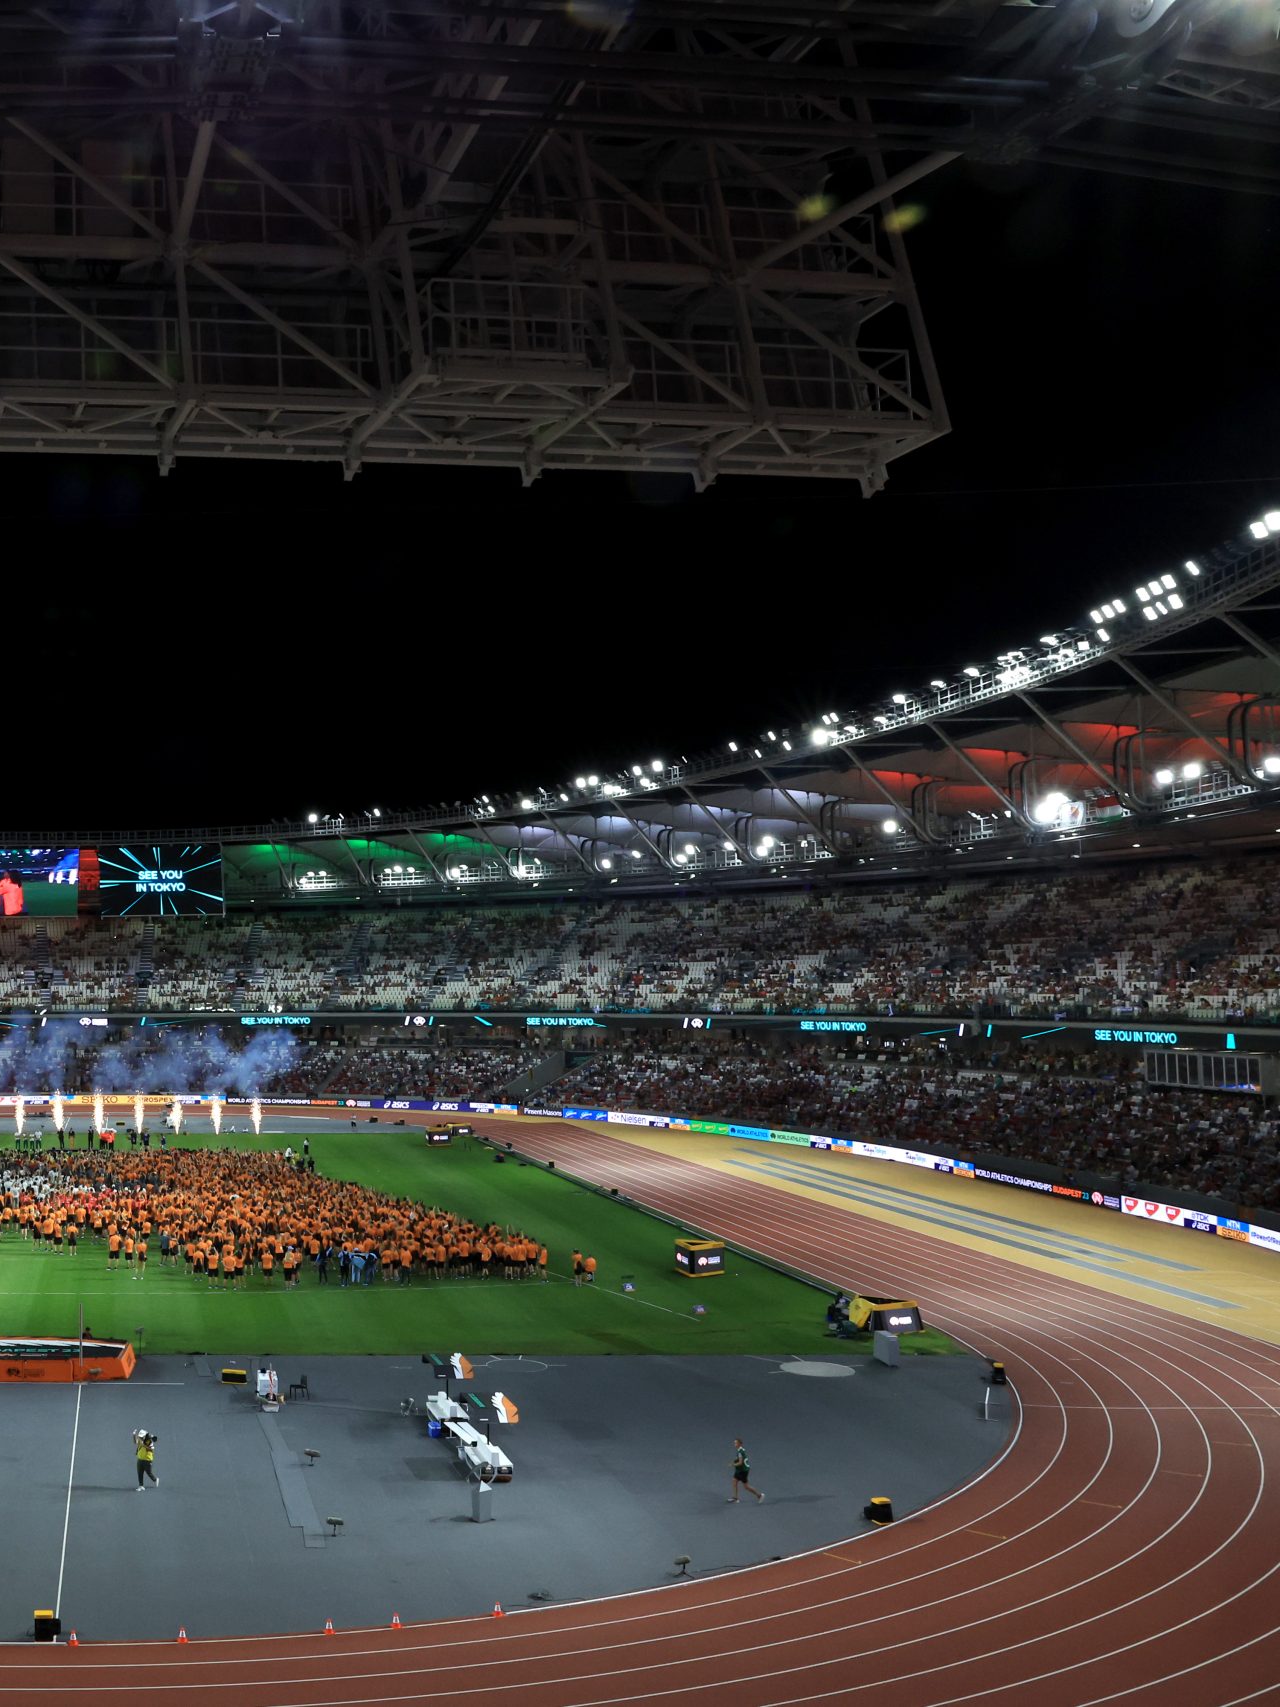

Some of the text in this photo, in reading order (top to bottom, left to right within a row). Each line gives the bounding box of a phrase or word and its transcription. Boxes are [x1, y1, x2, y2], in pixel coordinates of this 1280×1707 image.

[138, 870, 183, 880] SEE YOU
[135, 882, 186, 892] IN TOKYO
[241, 1017, 311, 1025] SEE YOU IN TOKYO
[526, 1017, 594, 1026] SEE YOU IN TOKYO
[800, 1021, 867, 1032] SEE YOU IN TOKYO
[1094, 1029, 1177, 1044] SEE YOU IN TOKYO
[81, 1095, 119, 1104] SEKO
[620, 1114, 647, 1125] Nielsen
[975, 1168, 990, 1179] WORLD
[990, 1172, 1014, 1184] ATHLETICS
[1014, 1177, 1053, 1192] CHAMPIONSHIPS
[1052, 1185, 1082, 1199] BUDAPEST
[1195, 1212, 1209, 1223] TDK
[1226, 1219, 1241, 1230] NTN
[1221, 1228, 1247, 1241] SEIKO
